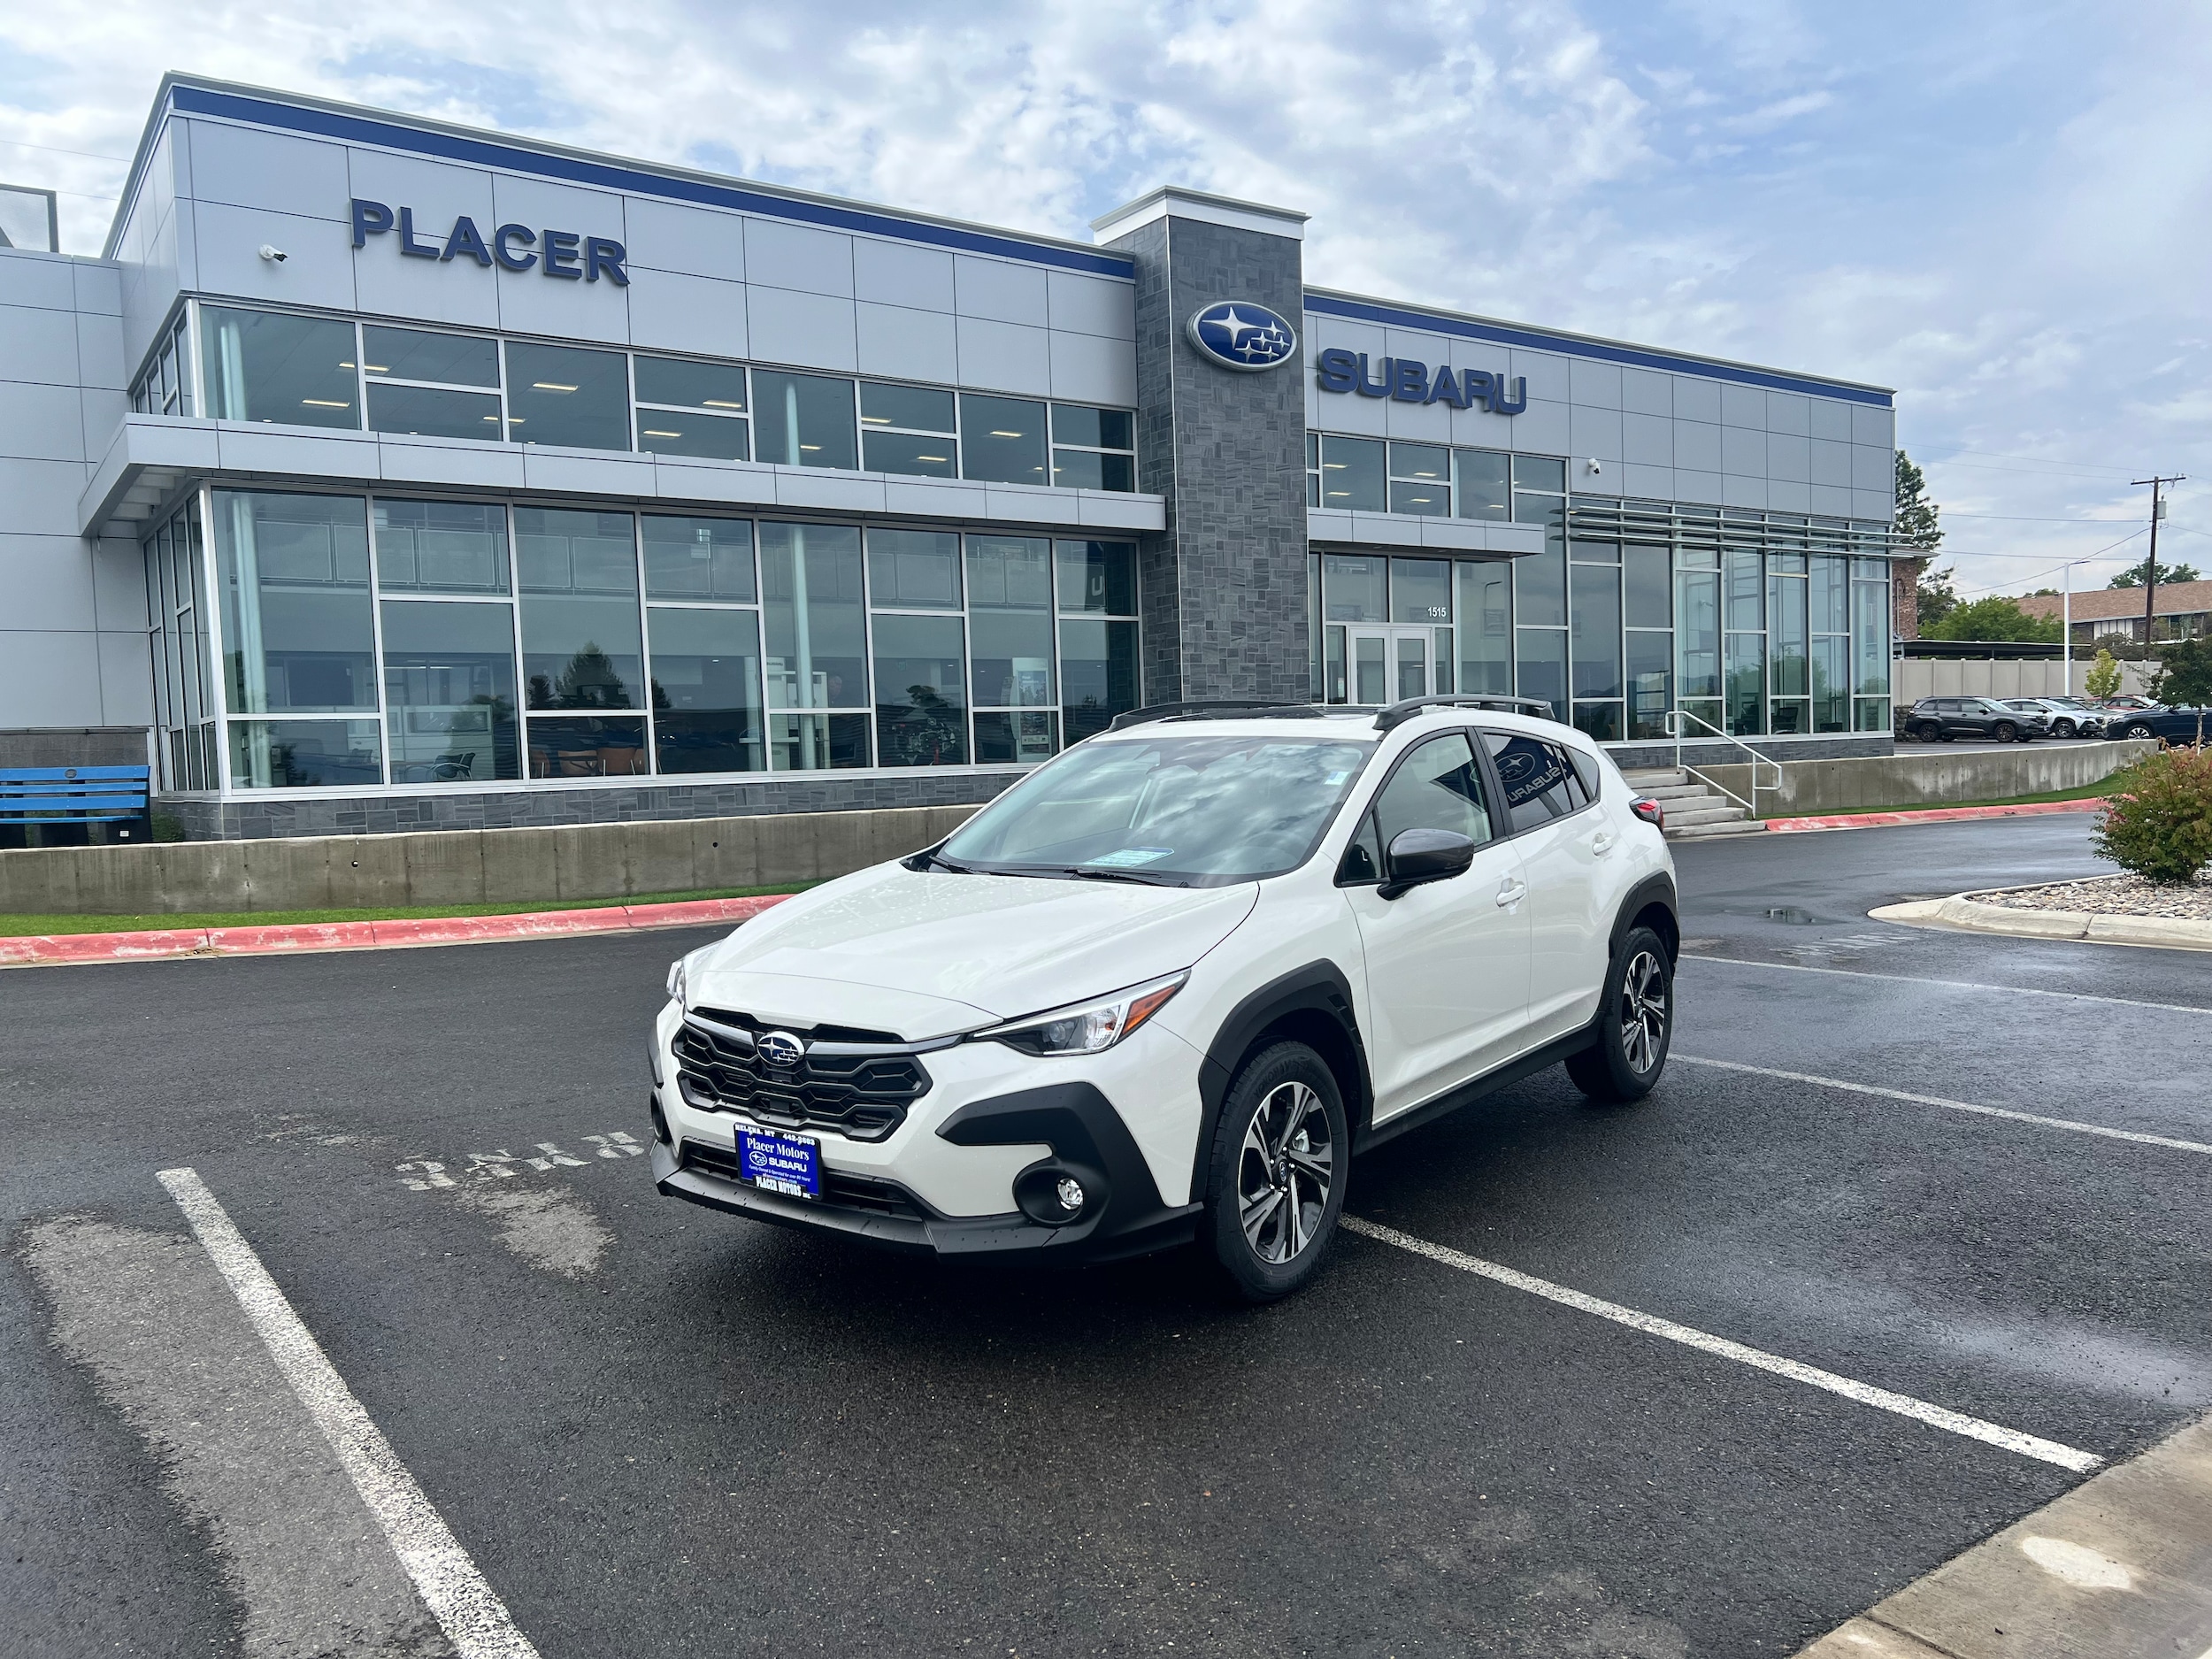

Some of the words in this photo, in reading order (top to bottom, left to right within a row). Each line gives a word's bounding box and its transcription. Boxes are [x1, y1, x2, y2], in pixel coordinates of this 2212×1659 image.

[349, 197, 631, 287] PLACER
[1319, 348, 1527, 414] SUBARU
[1427, 606, 1447, 618] 1515
[764, 1129, 776, 1138] MT
[746, 1137, 775, 1154] Placer
[776, 1143, 810, 1161] Motors
[768, 1157, 807, 1172] SUBARU
[756, 1176, 779, 1192] PLACER
[778, 1180, 802, 1197] MOTORS
